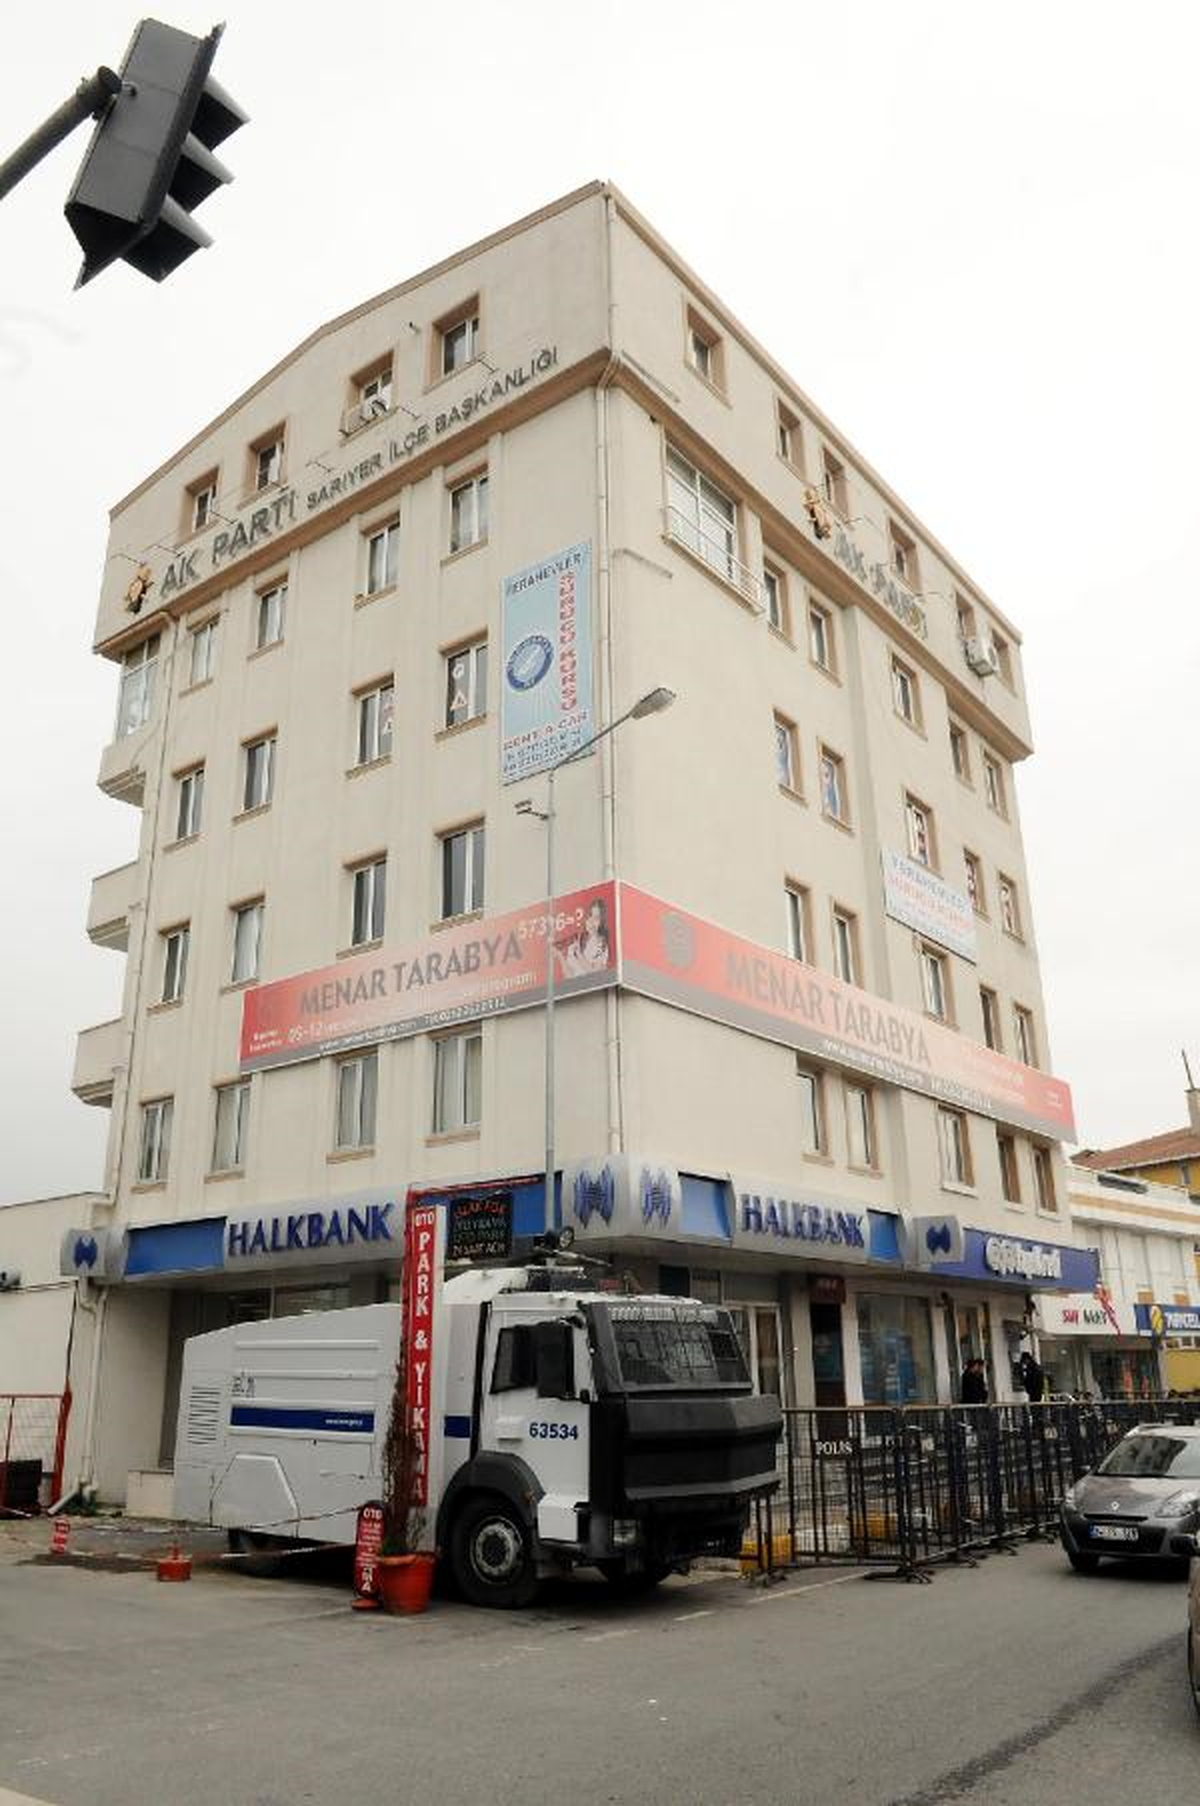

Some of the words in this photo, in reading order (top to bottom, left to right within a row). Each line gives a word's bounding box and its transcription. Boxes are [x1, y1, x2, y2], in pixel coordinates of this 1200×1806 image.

[160, 550, 199, 598] AK
[299, 968, 387, 1016] MENAR
[393, 930, 523, 993] TARABYA
[725, 951, 827, 1027] MENAR
[831, 987, 932, 1066] TARABYA
[228, 1202, 394, 1257] HALKBANK
[415, 1210, 435, 1227] OTO
[740, 1193, 865, 1249] HALKBANK
[417, 1231, 431, 1318] PARK
[529, 1421, 579, 1440] 63534
